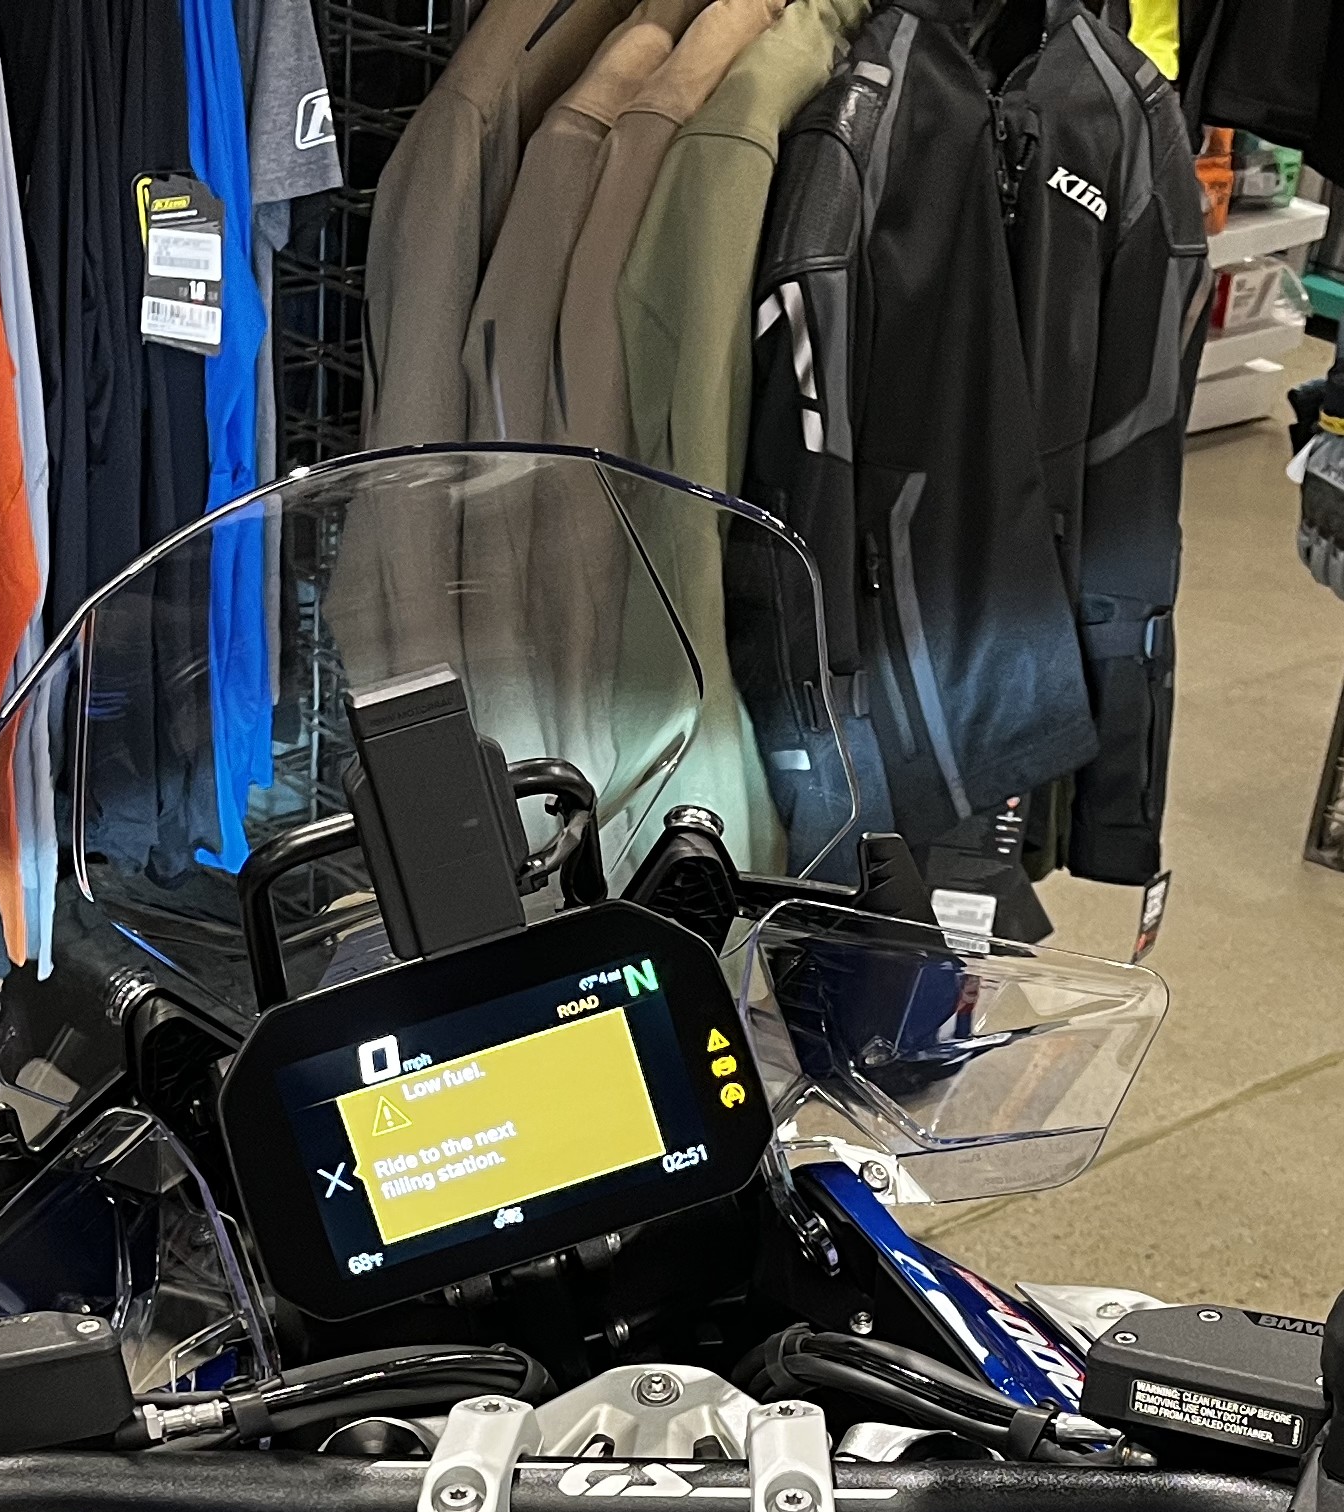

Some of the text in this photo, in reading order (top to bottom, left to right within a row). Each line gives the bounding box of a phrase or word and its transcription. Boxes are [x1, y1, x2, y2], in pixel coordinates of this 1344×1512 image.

[622, 958, 659, 997] N
[556, 994, 600, 1018] ROAD
[358, 1034, 433, 1085] 0 mph
[401, 1061, 486, 1101] Low fuel.
[374, 1120, 517, 1179] Ride to the next
[662, 1143, 708, 1173] 02:51
[380, 1150, 506, 1200] filling station.
[1258, 1315, 1325, 1336] BMW
[1135, 1391, 1248, 1426] REMOVING. USE ONLY DOT 4
[1135, 1402, 1159, 1416] FLUID
[1159, 1408, 1183, 1422] FROM
[1190, 1414, 1223, 1431] SEALED
[1224, 1423, 1274, 1442] CONTAINER.
[1137, 1381, 1291, 1425] WARNING: CLEAN FILLER CAP BEFORE
